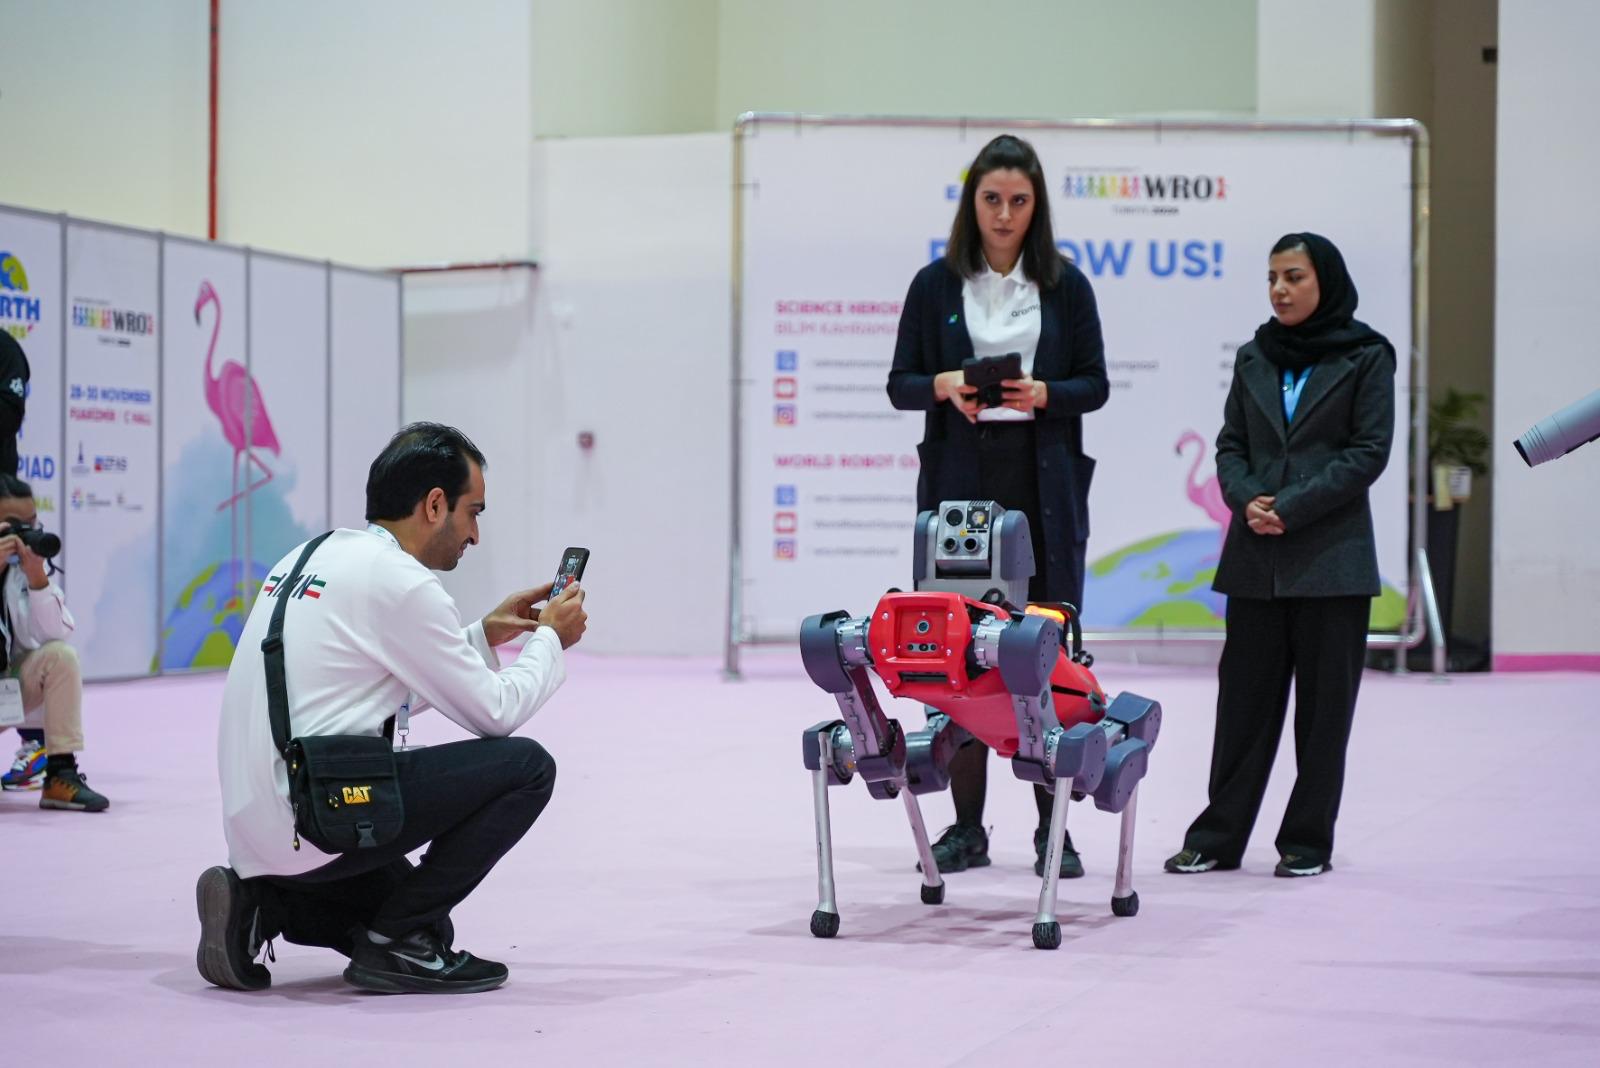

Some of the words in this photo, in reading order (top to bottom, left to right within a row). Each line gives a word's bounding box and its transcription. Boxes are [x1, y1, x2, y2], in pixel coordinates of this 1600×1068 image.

[1145, 174, 1212, 200] WRO
[1149, 240, 1223, 277] US!
[113, 311, 147, 335] WRO
[342, 786, 370, 804] CAT
